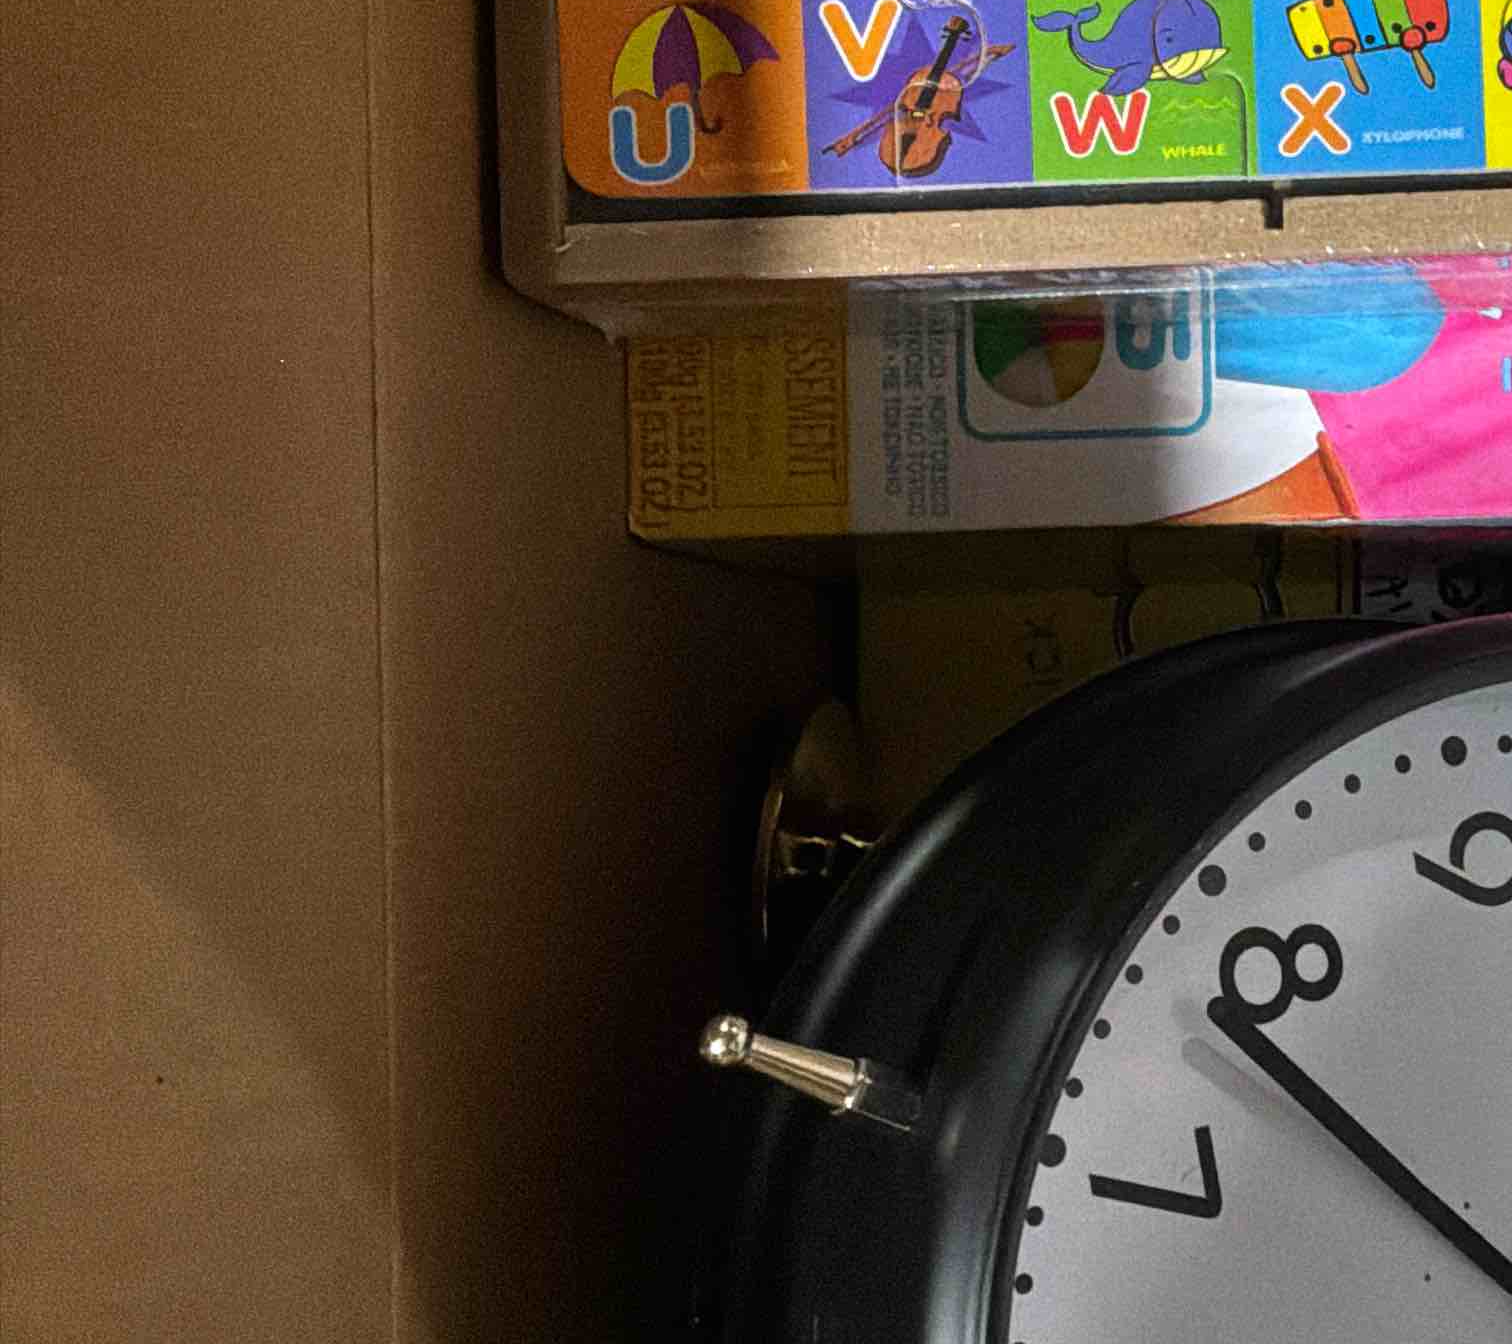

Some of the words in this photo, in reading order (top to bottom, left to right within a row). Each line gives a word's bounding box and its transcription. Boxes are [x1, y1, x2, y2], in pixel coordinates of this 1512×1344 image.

[608, 102, 696, 185] U
[1051, 89, 1151, 158] W
[1161, 143, 1227, 160] WHALE
[1278, 82, 1352, 157] X
[1361, 126, 1465, 145] XYLOPHONE
[1219, 922, 1344, 1027] 8
[1088, 1125, 1223, 1221] 7
